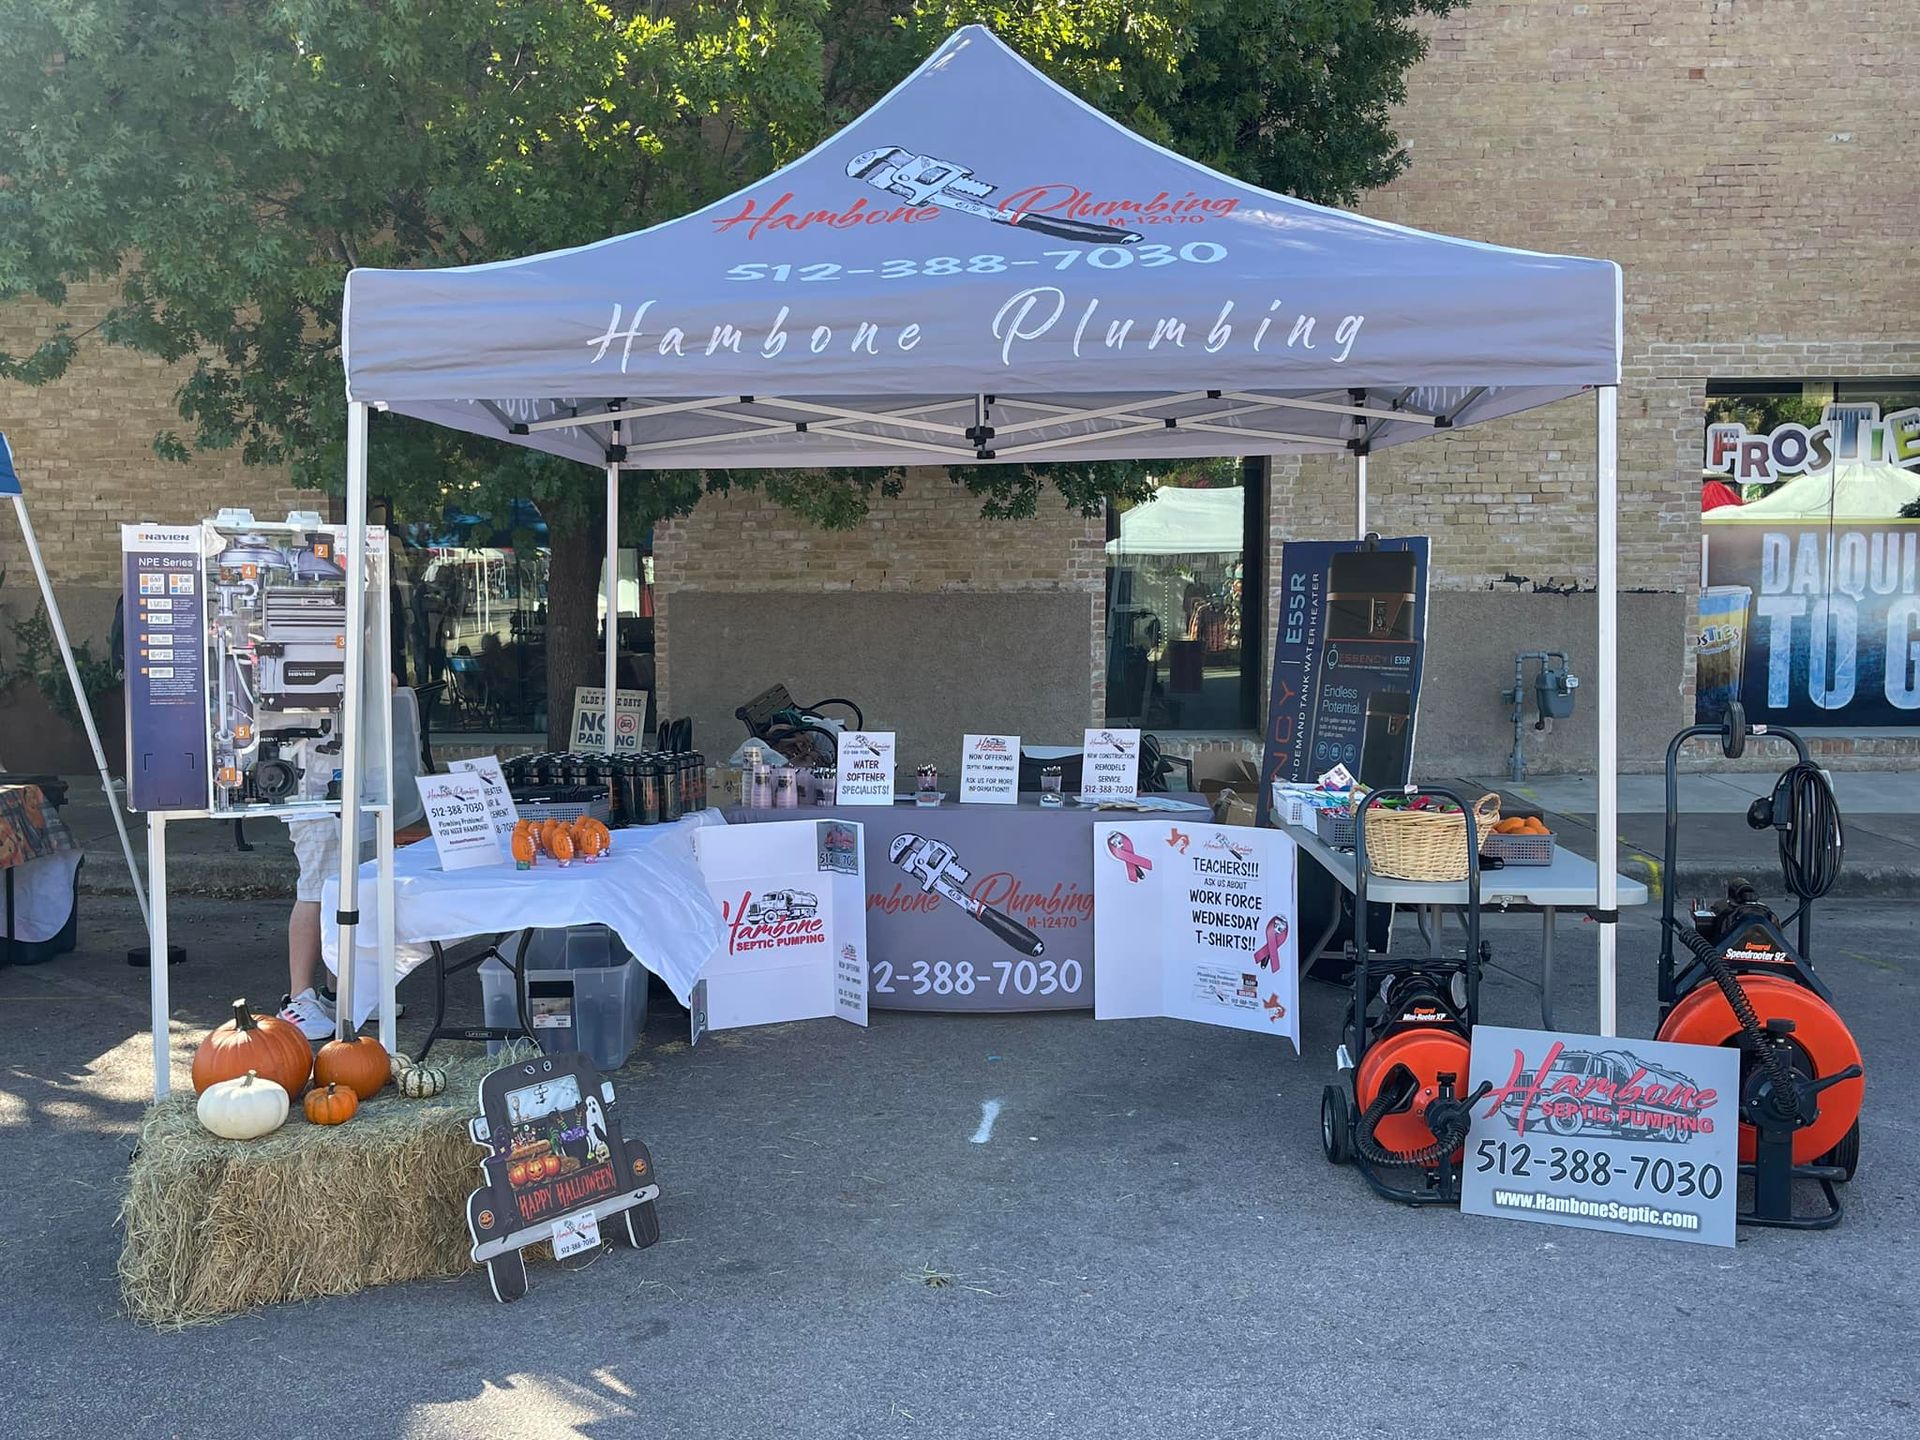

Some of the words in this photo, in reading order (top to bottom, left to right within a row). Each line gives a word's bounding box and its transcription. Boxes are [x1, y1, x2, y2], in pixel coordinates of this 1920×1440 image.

[712, 192, 942, 241] Hambone
[997, 184, 1240, 226] Plumbing
[1108, 215, 1205, 226] M-12470
[724, 241, 1228, 282] 512-388-7030
[587, 300, 922, 374] Hambone
[992, 286, 1365, 366] Plumbing
[138, 557, 160, 567] NPE
[162, 557, 193, 567] Series
[1285, 573, 1307, 644] E55R
[1309, 573, 1320, 625] HEATER
[1304, 628, 1317, 673] WATER
[1757, 596, 1858, 710] TO
[580, 695, 600, 705] OLDE
[1299, 675, 1311, 708] TANK
[1323, 684, 1358, 699] Endless
[578, 733, 635, 747] PARNG
[1291, 711, 1306, 782] N-DEMAND
[853, 759, 880, 770] WATER
[1098, 752, 1136, 760] CONSTRUCTION
[846, 772, 886, 782] SOFTENER
[1094, 763, 1126, 772] REMODELS
[986, 777, 997, 785] FOR
[998, 778, 1013, 786] MORE
[1083, 784, 1134, 794] 512-388-7030
[1097, 775, 1122, 783] SERVICE
[841, 785, 890, 796] SPECIALISTS!
[431, 801, 485, 818] 512-388-7030
[1192, 857, 1260, 878] TEACHERS!!!
[1204, 878, 1216, 887] ASK
[1217, 879, 1226, 888] US
[1227, 881, 1247, 890] ABOUT
[1189, 888, 1222, 905] WORK
[1225, 893, 1263, 910] FORCE
[722, 890, 824, 956] Hambone
[1027, 917, 1078, 929] M-12470
[1191, 909, 1260, 931] WEDNESDAY
[736, 939, 774, 952] SEPTIC
[776, 933, 825, 948] PUMPING
[1195, 930, 1256, 952] T-SHIRTS!!
[1725, 948, 1775, 961] Speedrooter
[1774, 951, 1786, 962] 92
[867, 958, 1083, 996] 2-388-7030
[1482, 1040, 1718, 1137] Hambone
[1540, 1101, 1613, 1123] SEPTIC
[1618, 1109, 1715, 1134] PUMPING
[1475, 1138, 1723, 1200] 512-388-7030
[518, 1184, 554, 1221] HAPPY
[555, 1162, 617, 1207] HALLOWEEN
[1495, 1190, 1699, 1230] www.HamboneSeptic.com
